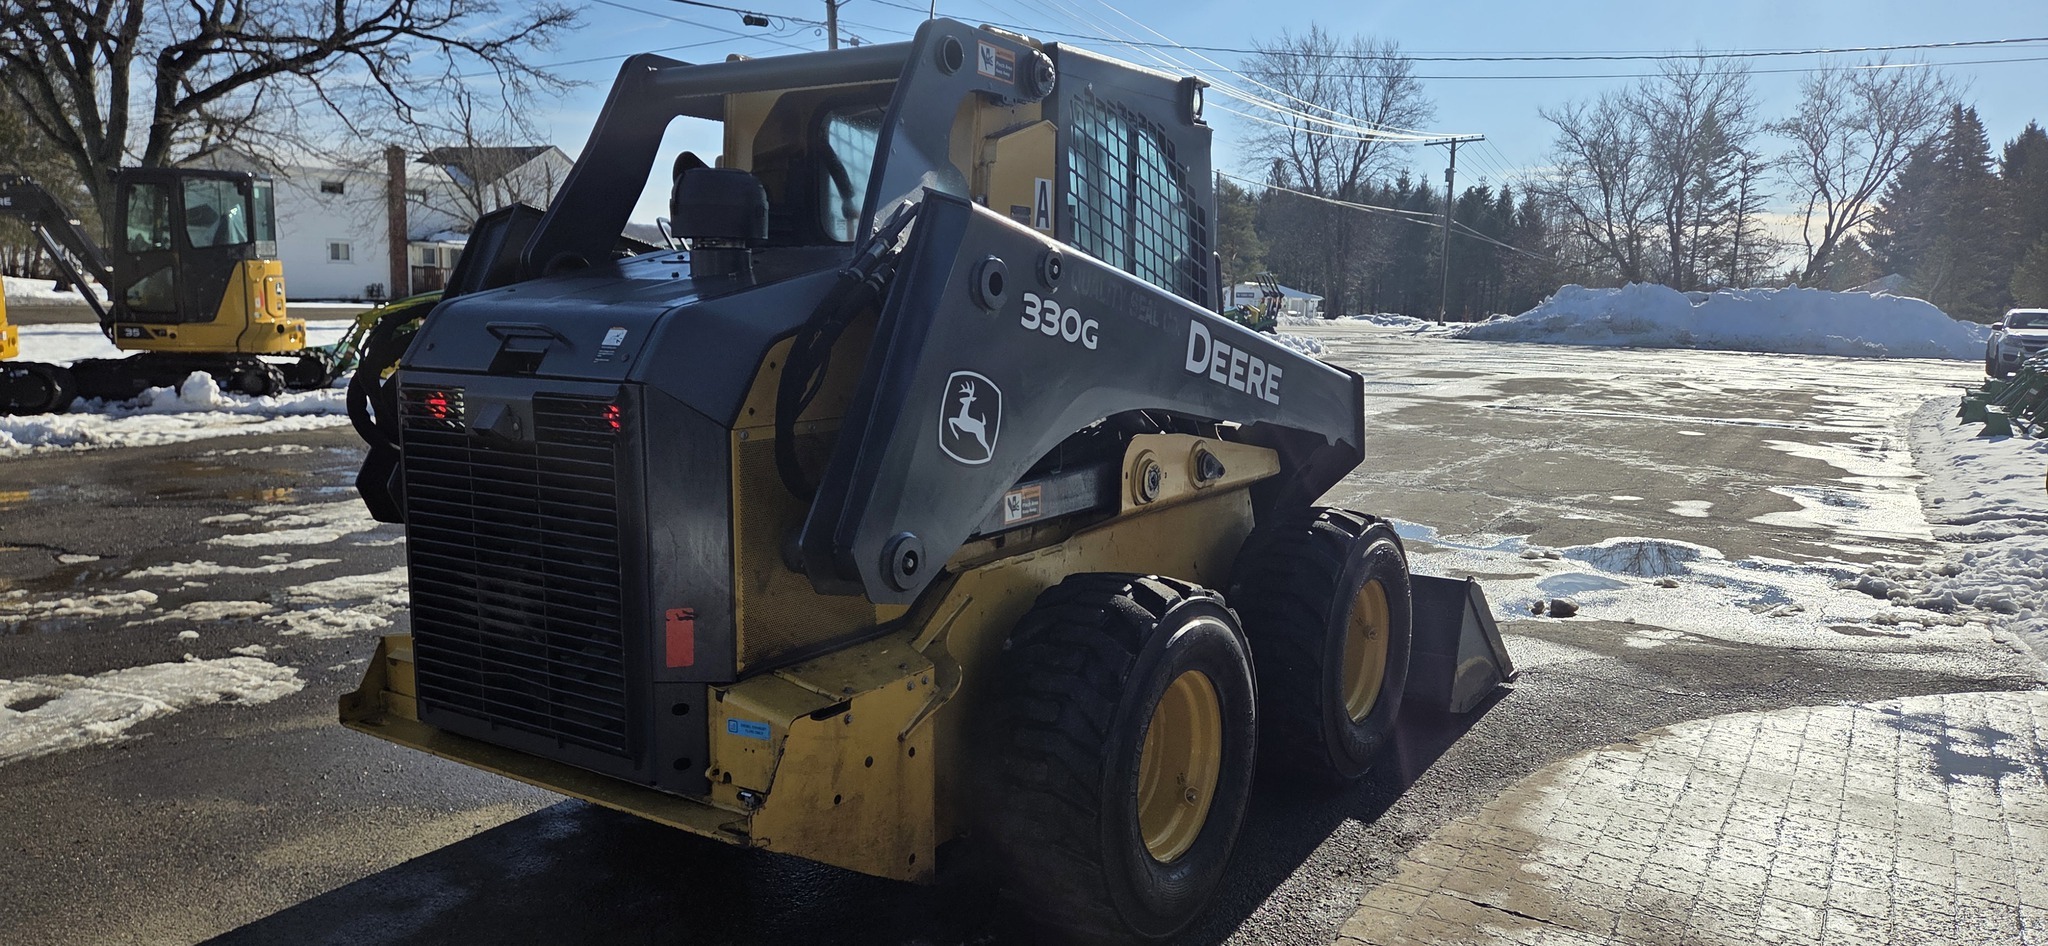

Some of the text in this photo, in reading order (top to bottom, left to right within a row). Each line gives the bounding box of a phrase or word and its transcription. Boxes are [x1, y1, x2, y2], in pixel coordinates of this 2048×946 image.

[1036, 181, 1050, 229] A
[125, 328, 140, 337] 35
[1021, 293, 1099, 350] 330G
[1185, 320, 1283, 405] DEERE
